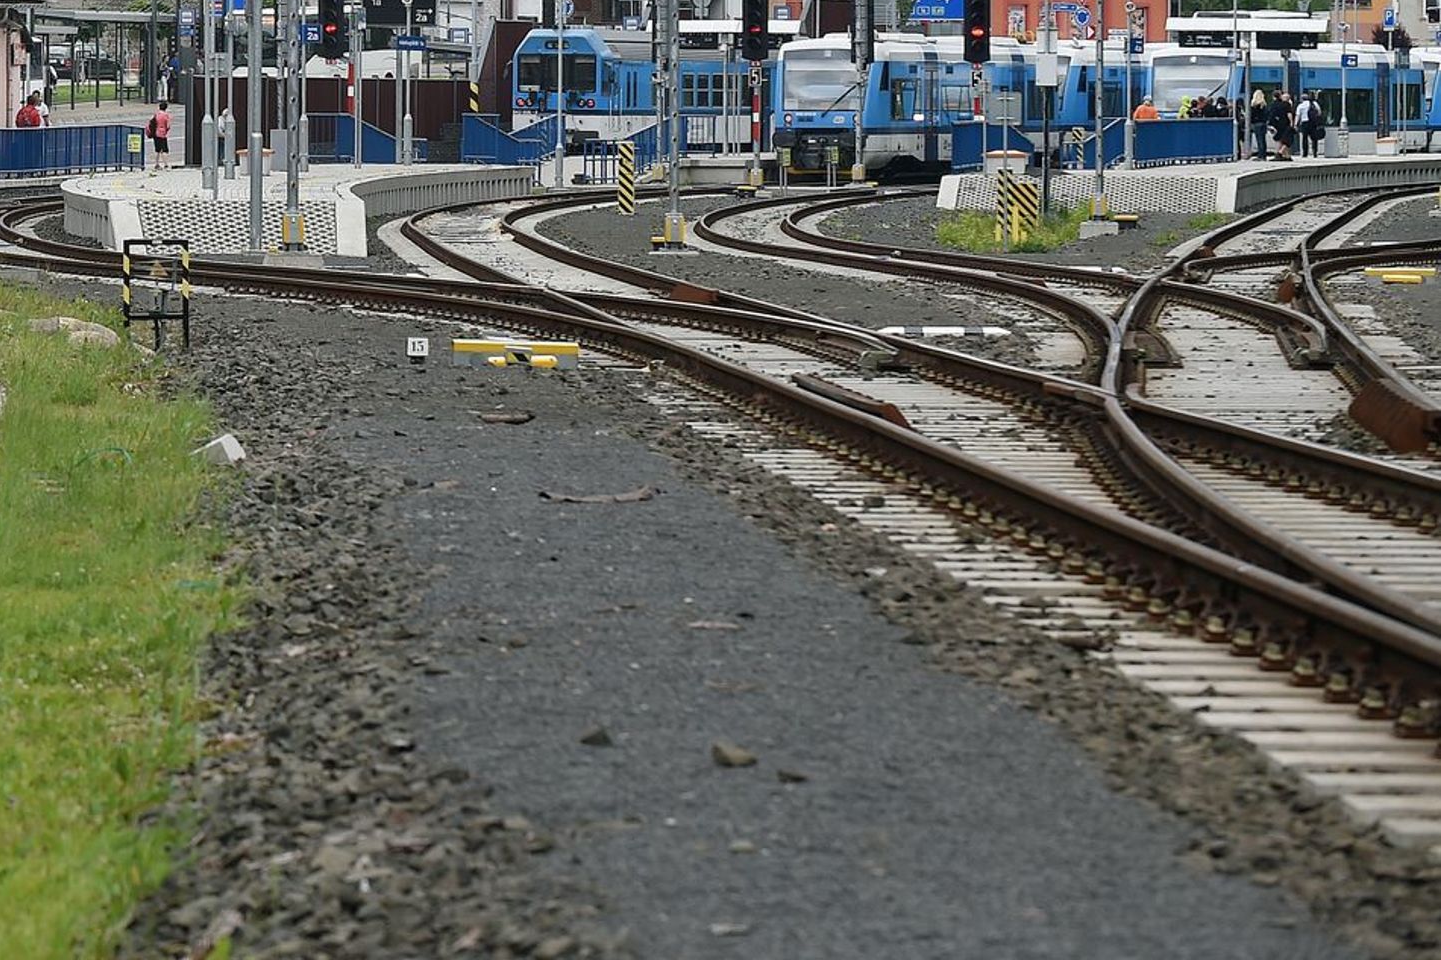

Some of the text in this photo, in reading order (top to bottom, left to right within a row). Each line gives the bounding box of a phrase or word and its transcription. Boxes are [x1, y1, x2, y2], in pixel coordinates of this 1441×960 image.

[415, 13, 427, 22] 2a
[306, 32, 319, 41] 2a
[751, 69, 759, 85] 5
[412, 341, 424, 351] 15
